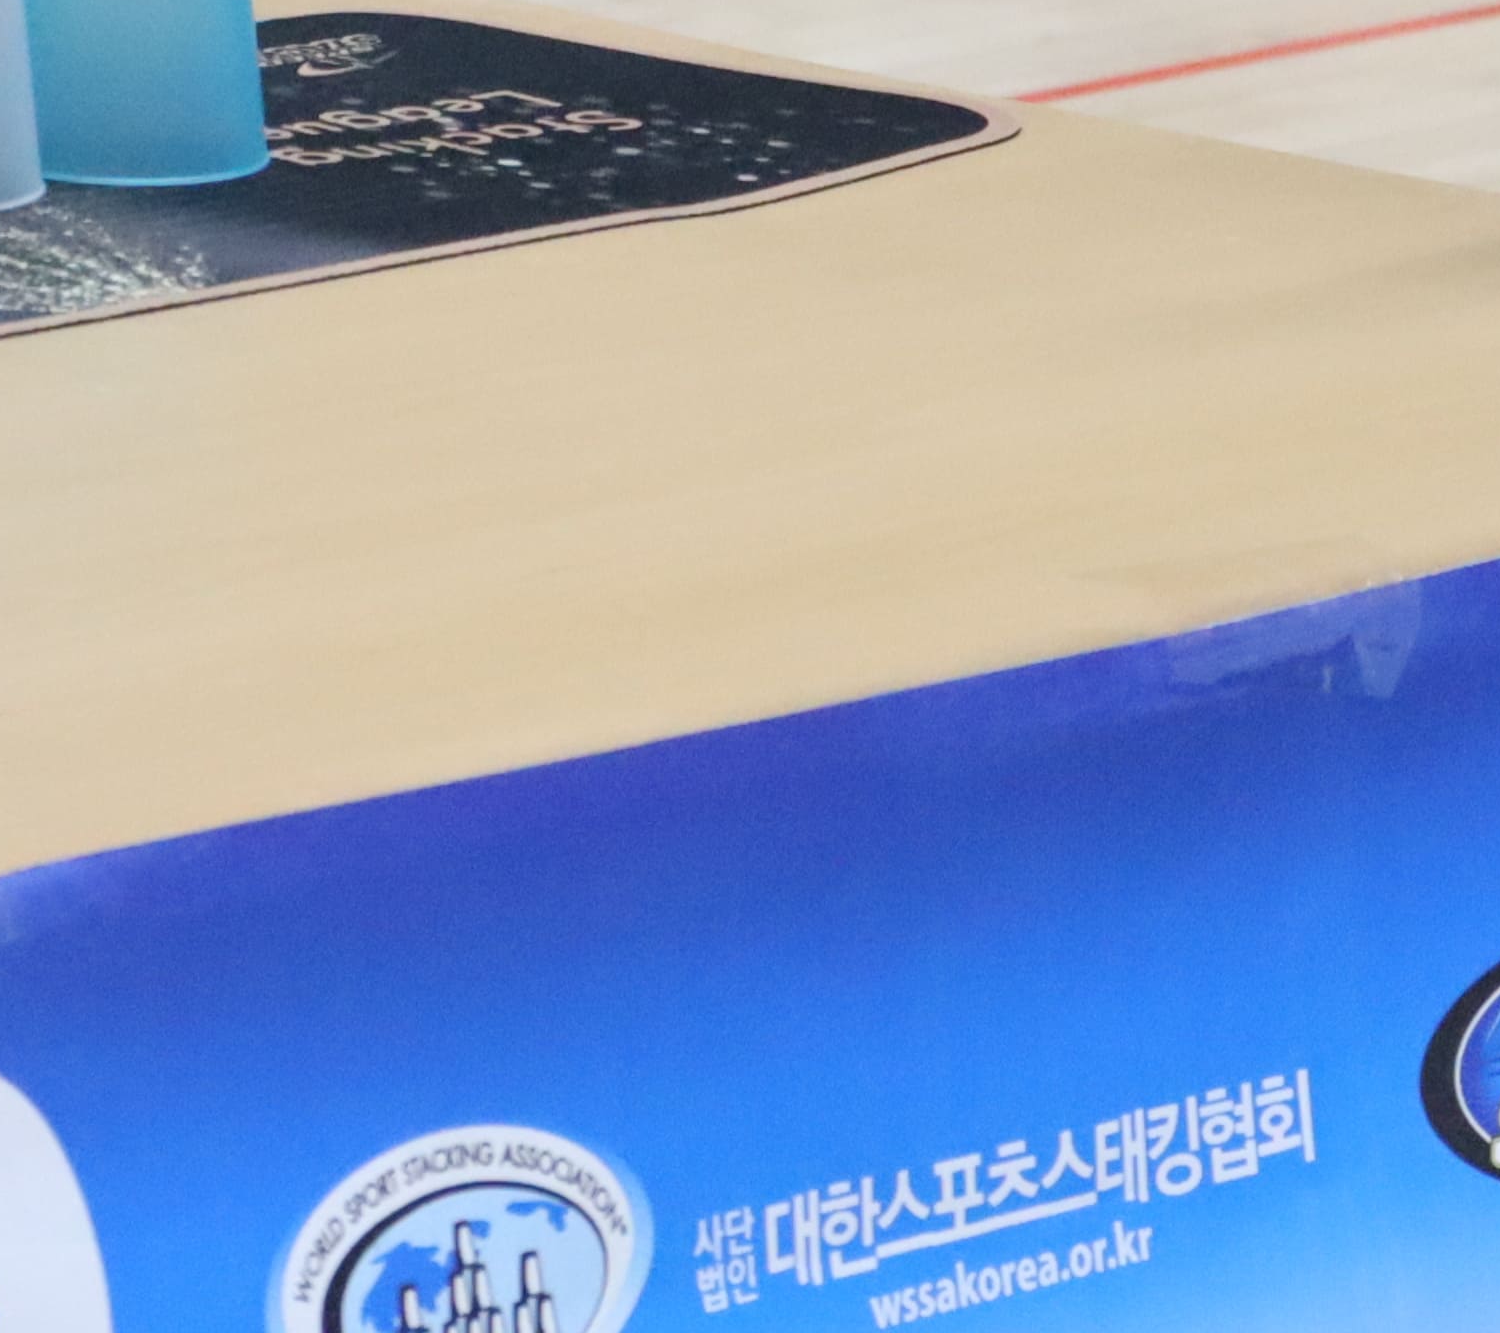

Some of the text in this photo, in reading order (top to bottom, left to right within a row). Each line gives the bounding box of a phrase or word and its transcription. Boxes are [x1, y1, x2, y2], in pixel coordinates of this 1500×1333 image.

[270, 109, 644, 167] Stacking
[765, 1067, 1317, 1287] 대한스포츠스태킹협회
[292, 1141, 620, 1303] WORLD SPORT STACKING ASSOCIATION
[693, 1205, 756, 1262] 사단
[695, 1254, 760, 1315] 법인
[869, 1220, 1154, 1330] wssakorea.or.kr
